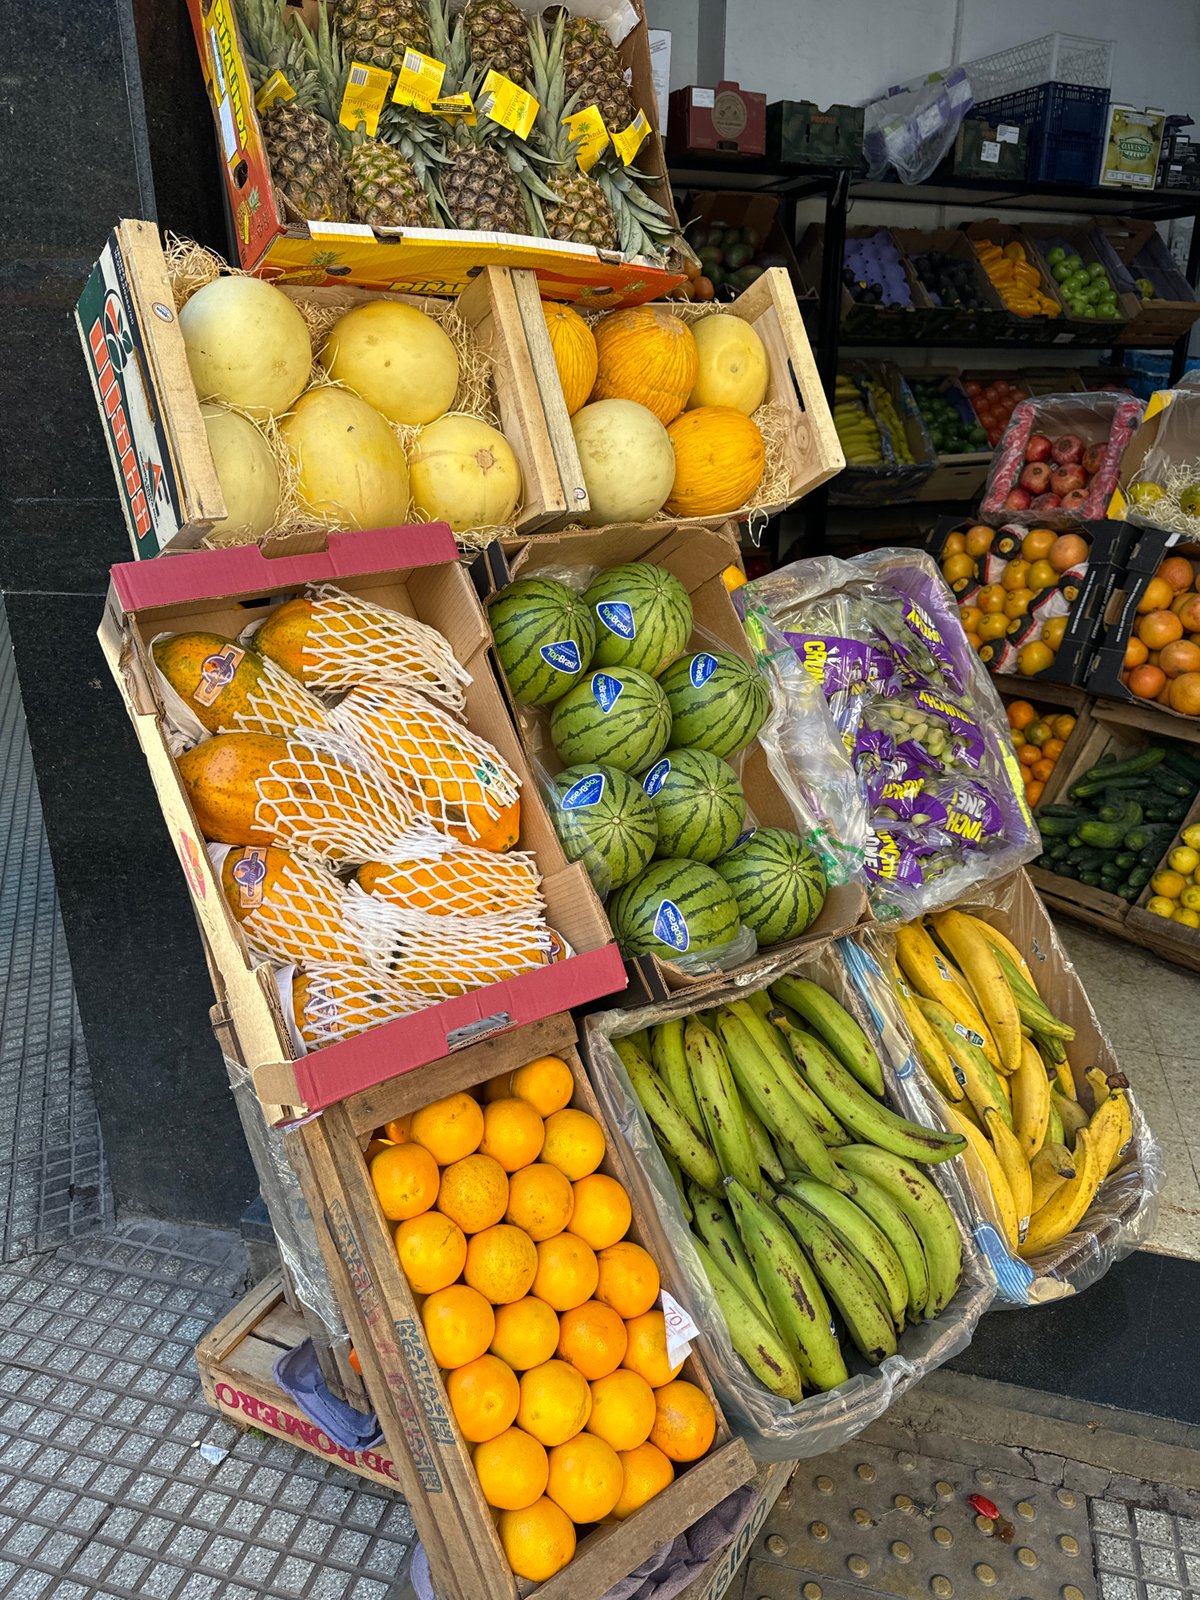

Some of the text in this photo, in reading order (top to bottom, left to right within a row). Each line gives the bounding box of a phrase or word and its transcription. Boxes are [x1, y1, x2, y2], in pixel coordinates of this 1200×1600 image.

[214, 0, 248, 151] PIÑALINDA
[602, 606, 631, 635] TopBrasil
[547, 647, 578, 671] TopBrasil
[697, 655, 708, 682] TopBrasil
[597, 676, 610, 707] TopBrasil
[567, 777, 600, 804] TopBrasil
[664, 906, 686, 946] TopBrasil
[407, 1323, 446, 1417] MATIAS
[215, 1382, 359, 1467] ROMERO
